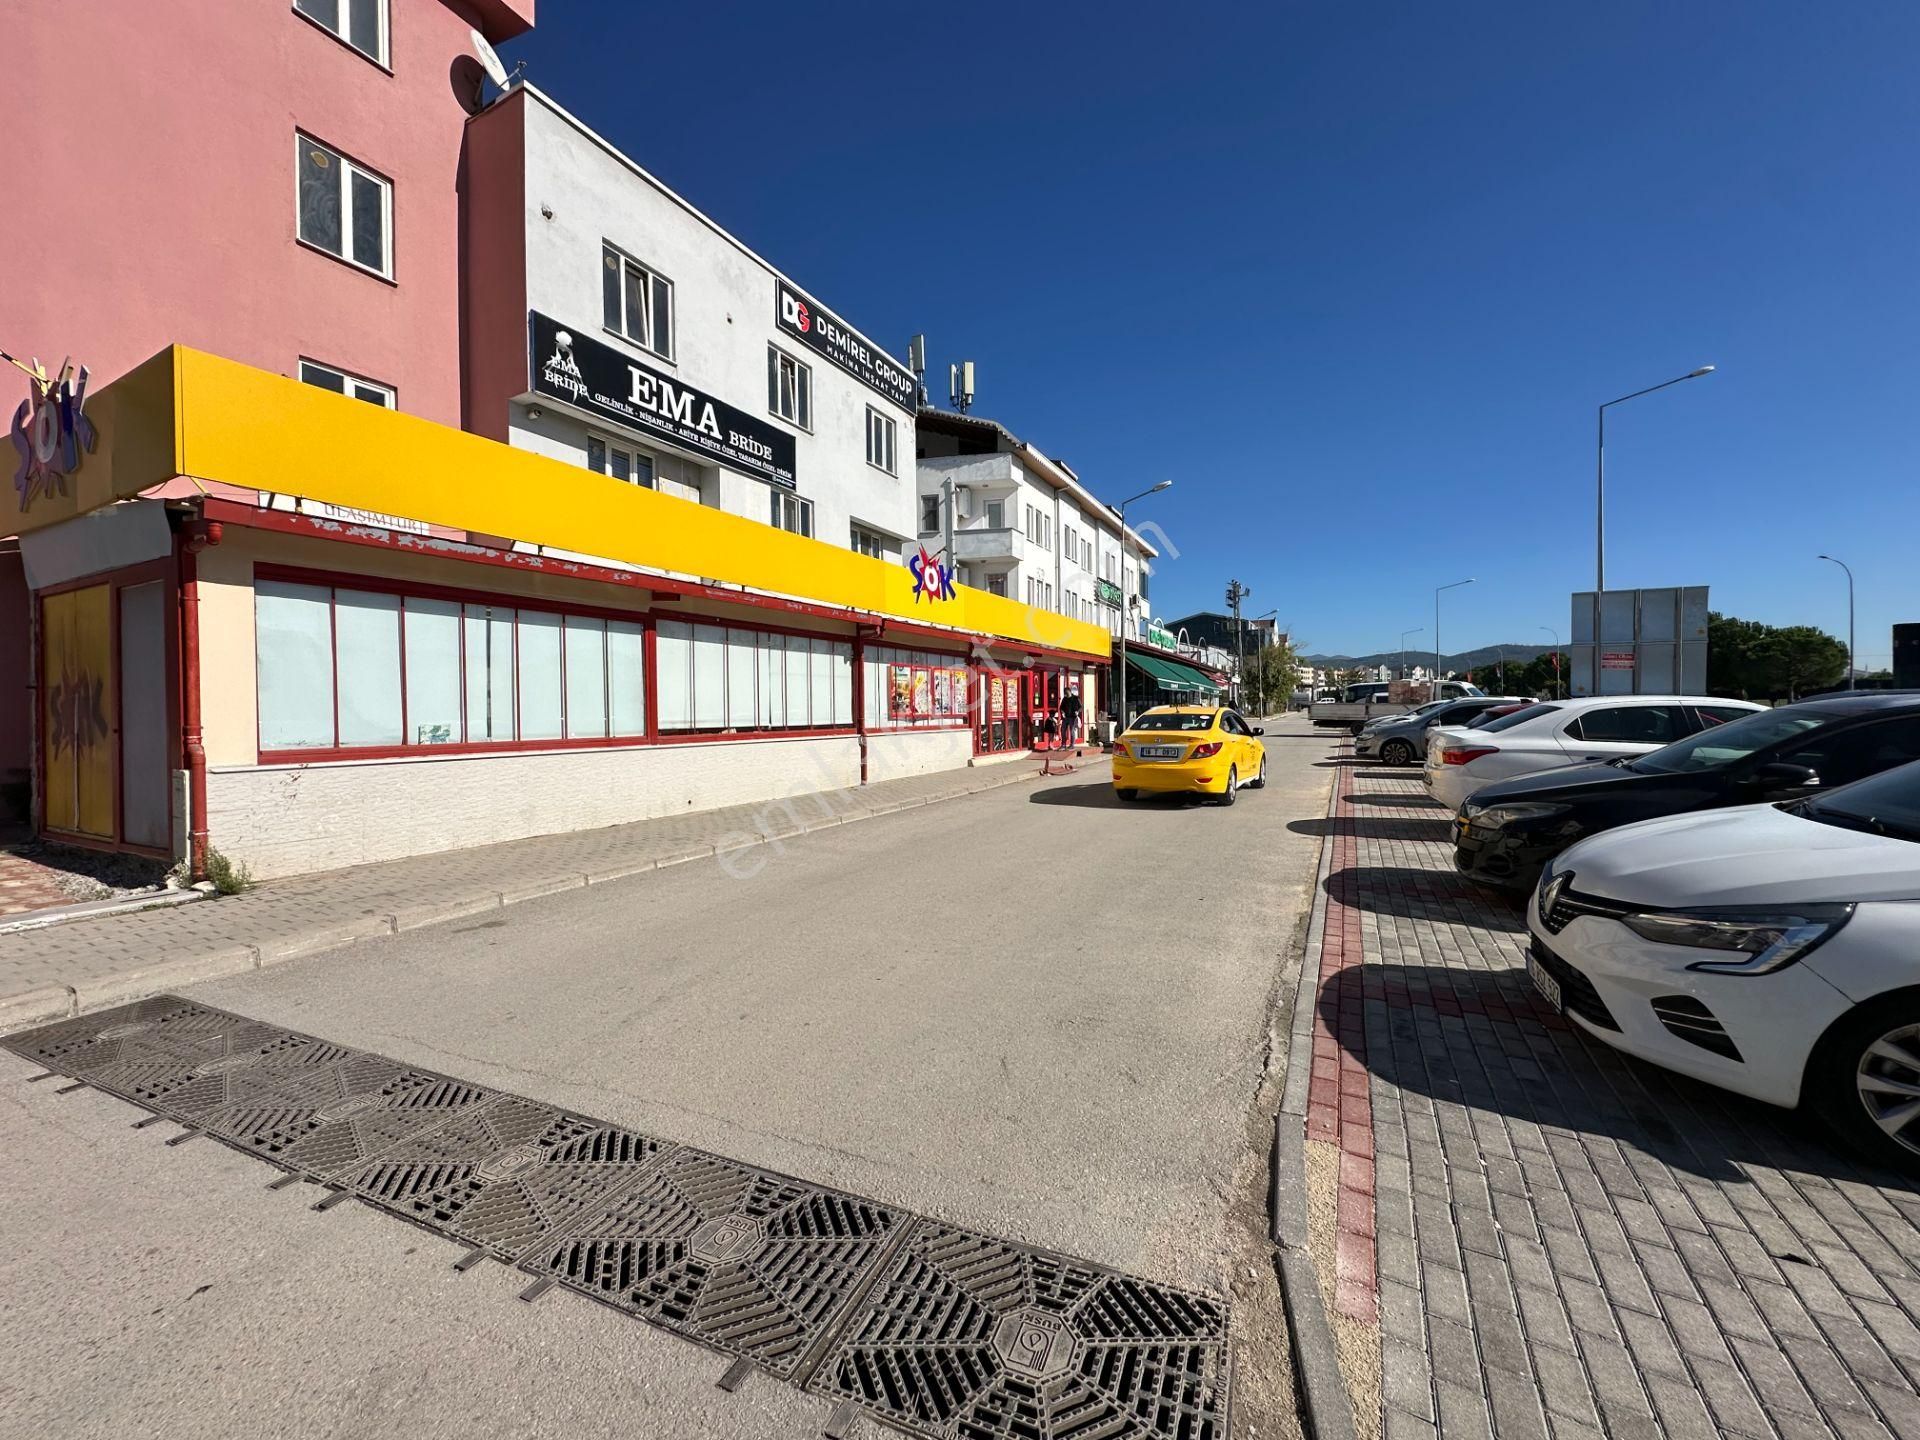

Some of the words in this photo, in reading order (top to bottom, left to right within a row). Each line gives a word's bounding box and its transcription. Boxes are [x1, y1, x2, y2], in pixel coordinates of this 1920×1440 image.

[816, 315, 873, 370] DEMİREL
[875, 359, 913, 395] GROUP
[594, 393, 634, 415] GELİNLİK
[639, 411, 675, 433] NİŞANLIK
[627, 364, 723, 441] EMA
[728, 430, 773, 461] BRİDE
